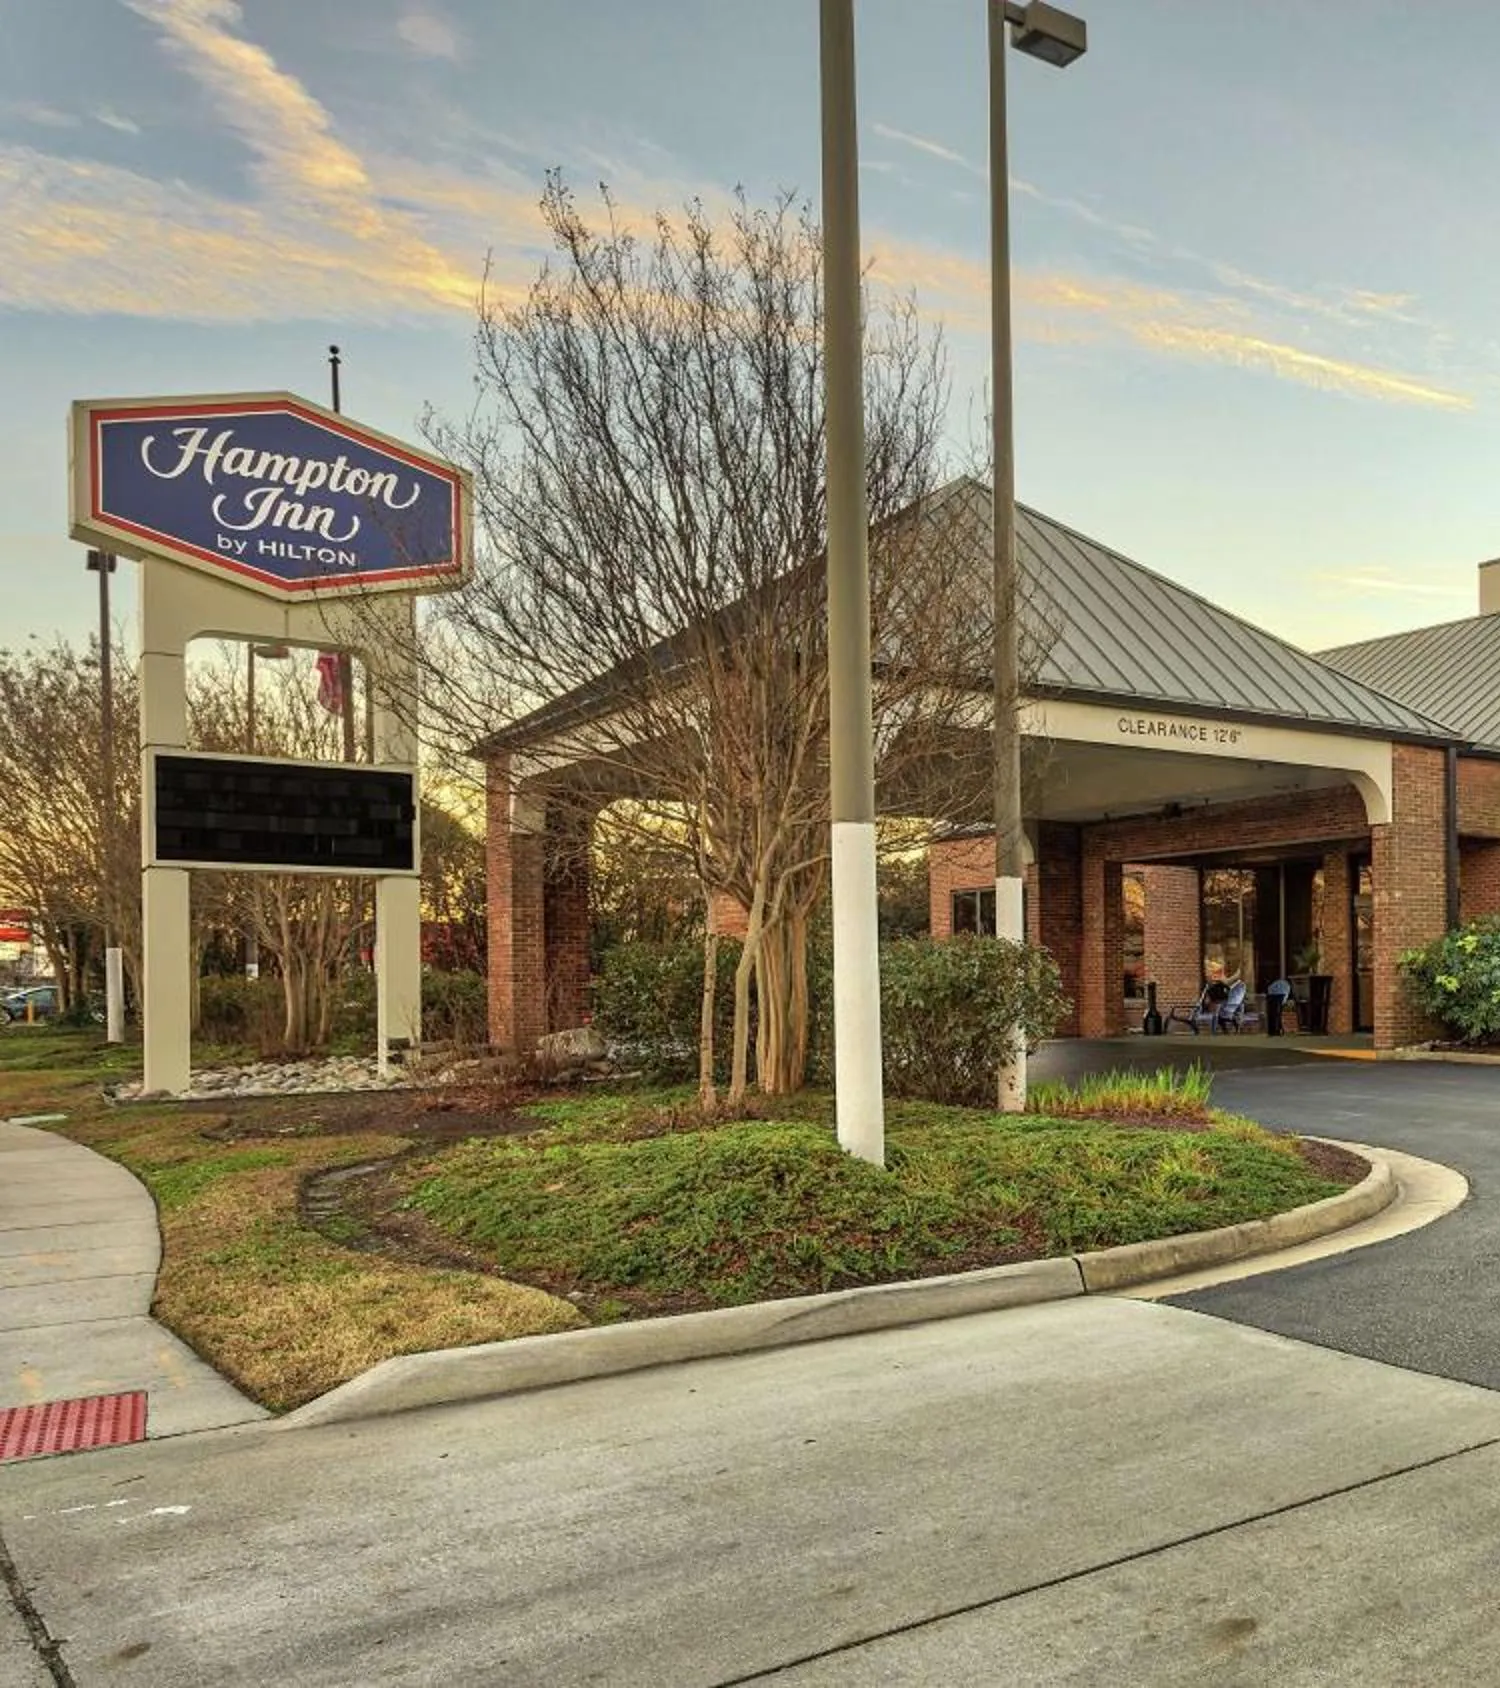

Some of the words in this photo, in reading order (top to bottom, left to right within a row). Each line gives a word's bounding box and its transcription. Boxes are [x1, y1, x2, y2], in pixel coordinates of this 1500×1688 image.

[141, 427, 421, 509] Hampton
[211, 487, 360, 542] Inn
[217, 533, 249, 556] by
[258, 539, 357, 567] HILTON
[1117, 717, 1207, 741] CLEARANCE
